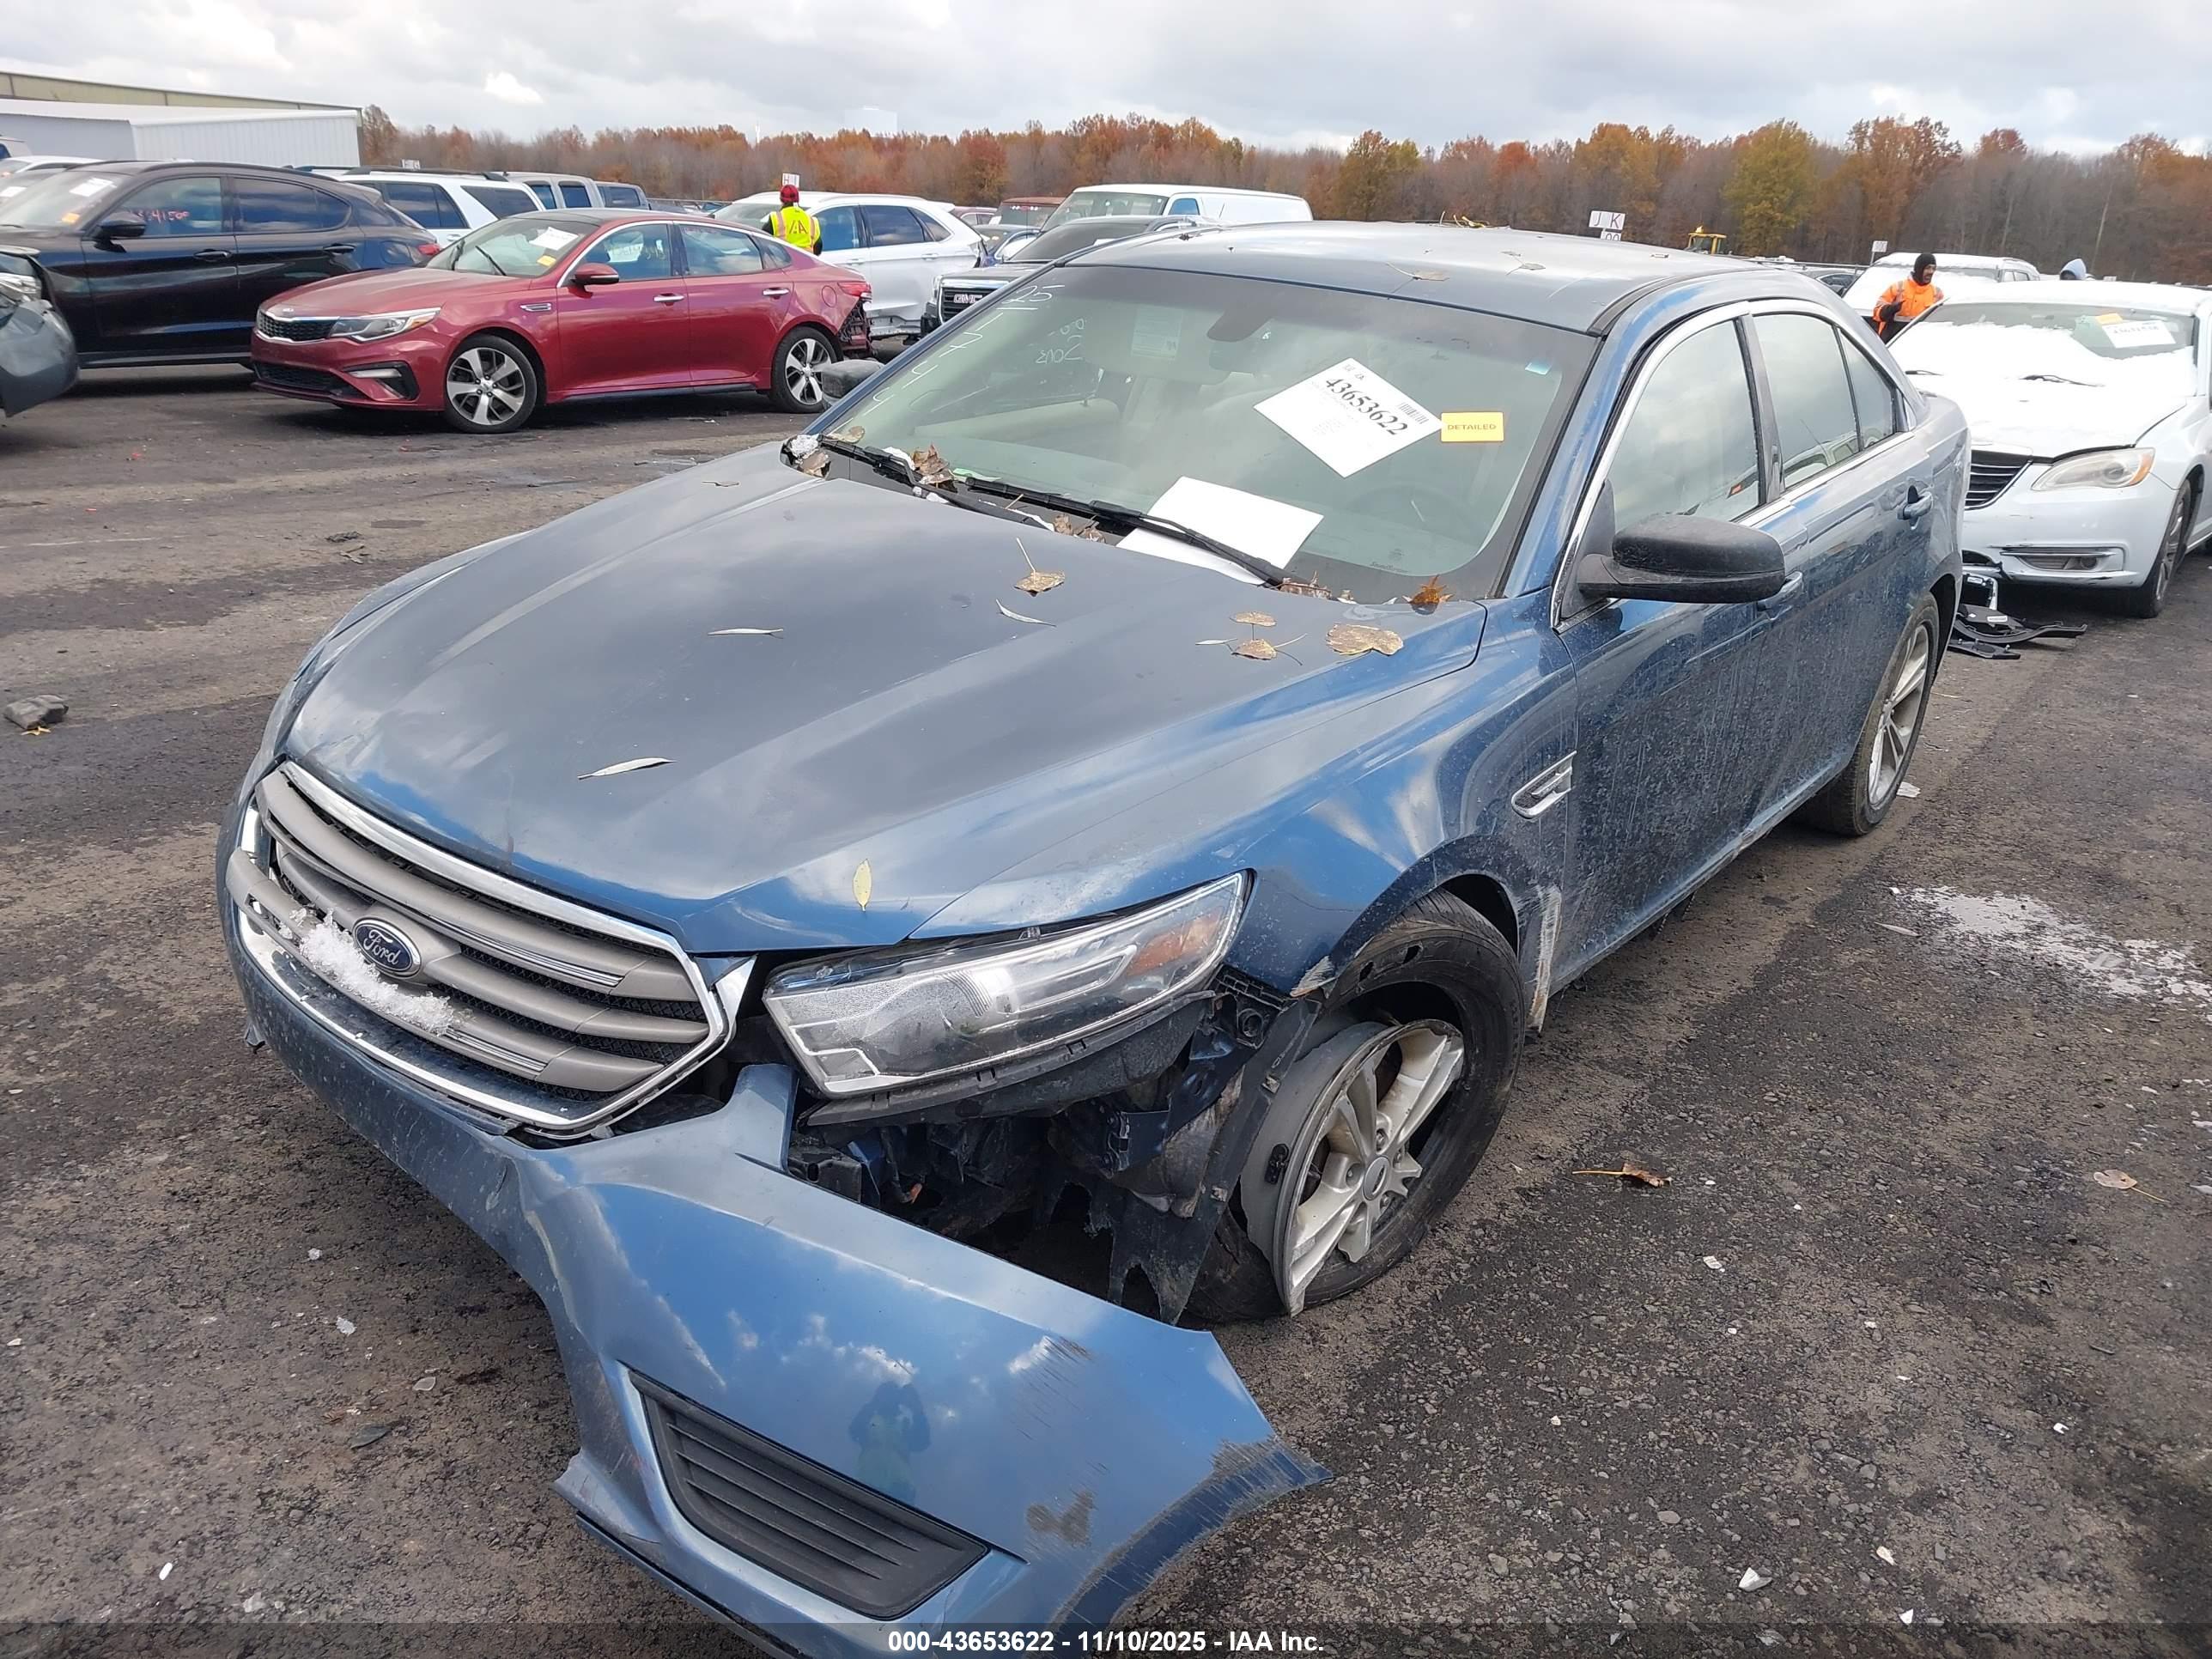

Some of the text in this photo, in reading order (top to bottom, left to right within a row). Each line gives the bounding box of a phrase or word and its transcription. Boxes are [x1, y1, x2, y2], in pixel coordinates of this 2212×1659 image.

[1594, 212, 1620, 228] J K
[1325, 378, 1408, 435] 43653622
[362, 928, 402, 965] Ford
